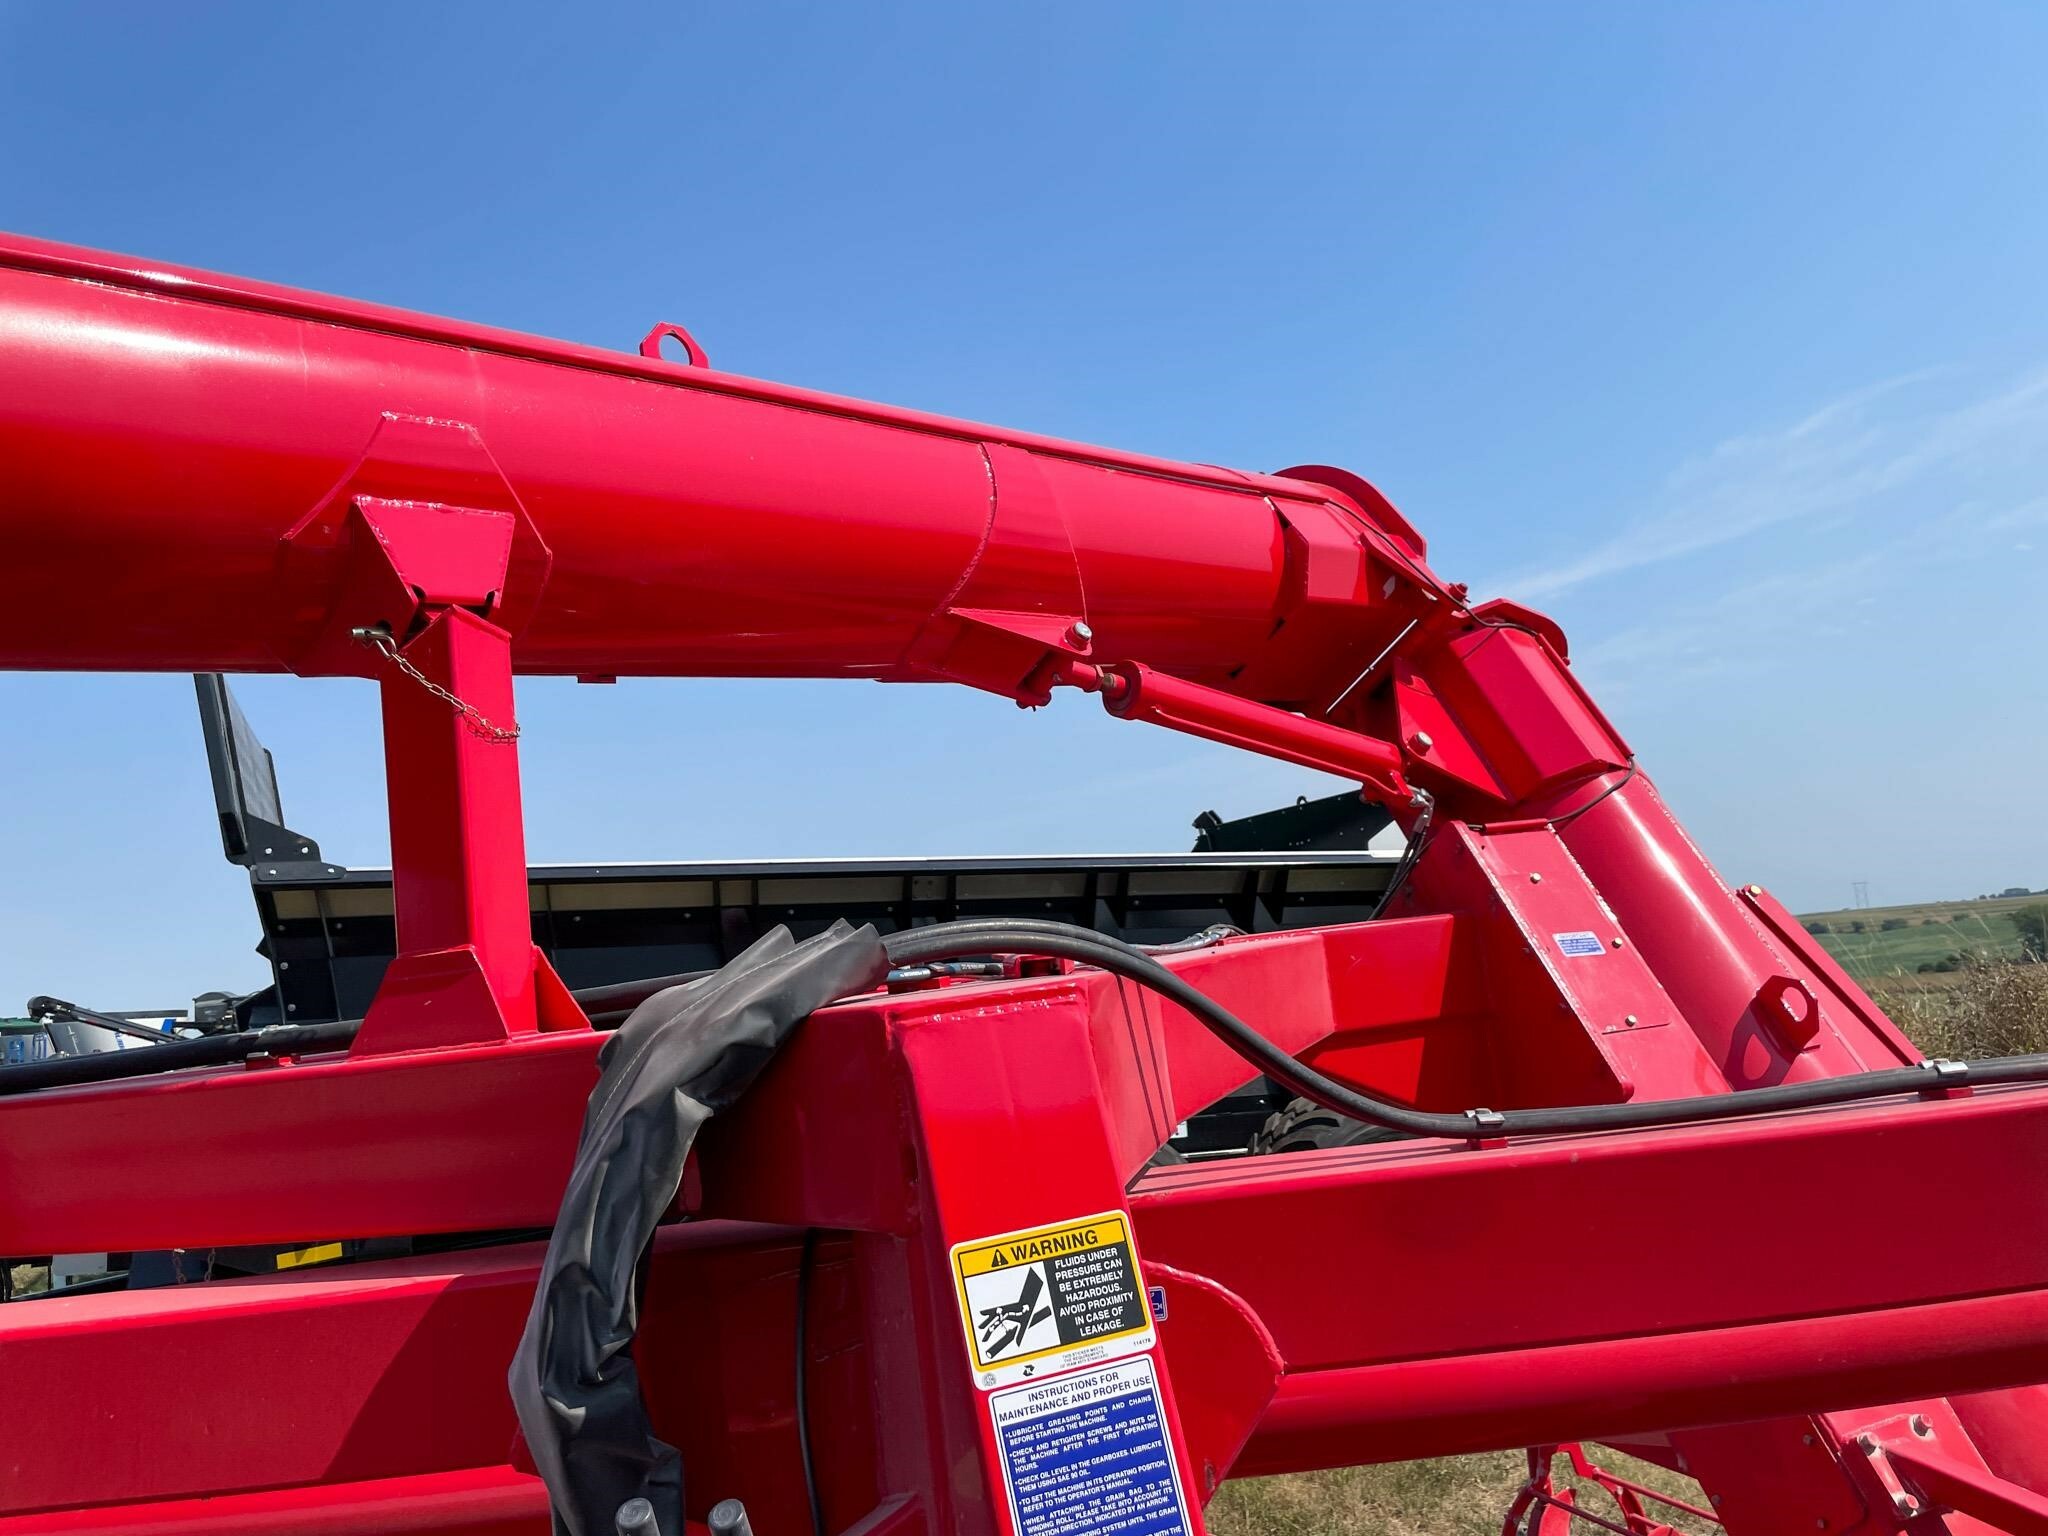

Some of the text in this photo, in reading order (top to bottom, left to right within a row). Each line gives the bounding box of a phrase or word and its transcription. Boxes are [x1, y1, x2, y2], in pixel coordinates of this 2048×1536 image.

[1011, 1230, 1098, 1260] WARNING
[1055, 1248, 1117, 1268] FLUIDS UNDER
[1055, 1258, 1122, 1281] PRESSURE CAN
[1059, 1270, 1123, 1292] BE EXTREMELY
[1060, 1292, 1133, 1317] AVOID PROXIMITY
[1066, 1283, 1122, 1303] HAZARDOUS.
[1075, 1306, 1123, 1326] IN CASE OF
[1080, 1319, 1124, 1336] LEAKAGE.
[999, 1376, 1151, 1421] MAINTENANCE AND PROPER USE
[1028, 1372, 1119, 1401] INSTRUCTIONS FOR
[1008, 1395, 1151, 1437] LUBRICATE GREASING POINTS AND CHAINS
[1010, 1434, 1035, 1445] BEFORE
[1036, 1426, 1065, 1438] STARTING
[1079, 1415, 1107, 1427] MACHINE.
[1012, 1447, 1033, 1457] CHECK
[1036, 1442, 1049, 1450] AND
[1052, 1433, 1085, 1446] RETIGHTEN
[1087, 1426, 1112, 1436] SCREWS
[1129, 1417, 1145, 1425] NUTS
[1014, 1422, 1158, 1465] THE MACHINE AFTER THE FIRST OPERATING
[1018, 1475, 1039, 1485] CHECK
[1051, 1466, 1070, 1475] LEVEL
[1079, 1460, 1090, 1468] THE
[1130, 1441, 1162, 1454] LUBRICATE
[1019, 1483, 1036, 1492] THEM
[1038, 1478, 1056, 1487] USING
[1058, 1474, 1070, 1482] SAE
[1032, 1494, 1043, 1502] SET
[1058, 1483, 1085, 1495] MACHINE
[1104, 1468, 1137, 1482] OPERATING
[1024, 1503, 1044, 1513] REFER
[1055, 1496, 1067, 1504] THE
[1068, 1485, 1105, 1500] OPERATOR'S
[1026, 1515, 1045, 1525] WHEN
[1050, 1504, 1084, 1518] ATTACHING
[1089, 1499, 1101, 1507] THE
[1106, 1492, 1125, 1502] GRAIN
[1129, 1487, 1142, 1495] BAG
[1159, 1479, 1171, 1487] THE
[1028, 1521, 1054, 1533] WINDING
[1076, 1508, 1099, 1519] PLEASE
[1101, 1503, 1116, 1512] TAKE
[1118, 1499, 1132, 1507] INTO
[1134, 1490, 1162, 1502] ACCOUNT
[1095, 1508, 1126, 1522] INDICATED
[1146, 1496, 1169, 1507] ARROW.
[1102, 1521, 1126, 1532] SYSTEM
[1128, 1516, 1145, 1525] UNTIL
[1146, 1512, 1157, 1520] THE
[1159, 1506, 1177, 1516] GRAIN
[1170, 1525, 1182, 1533] THE
